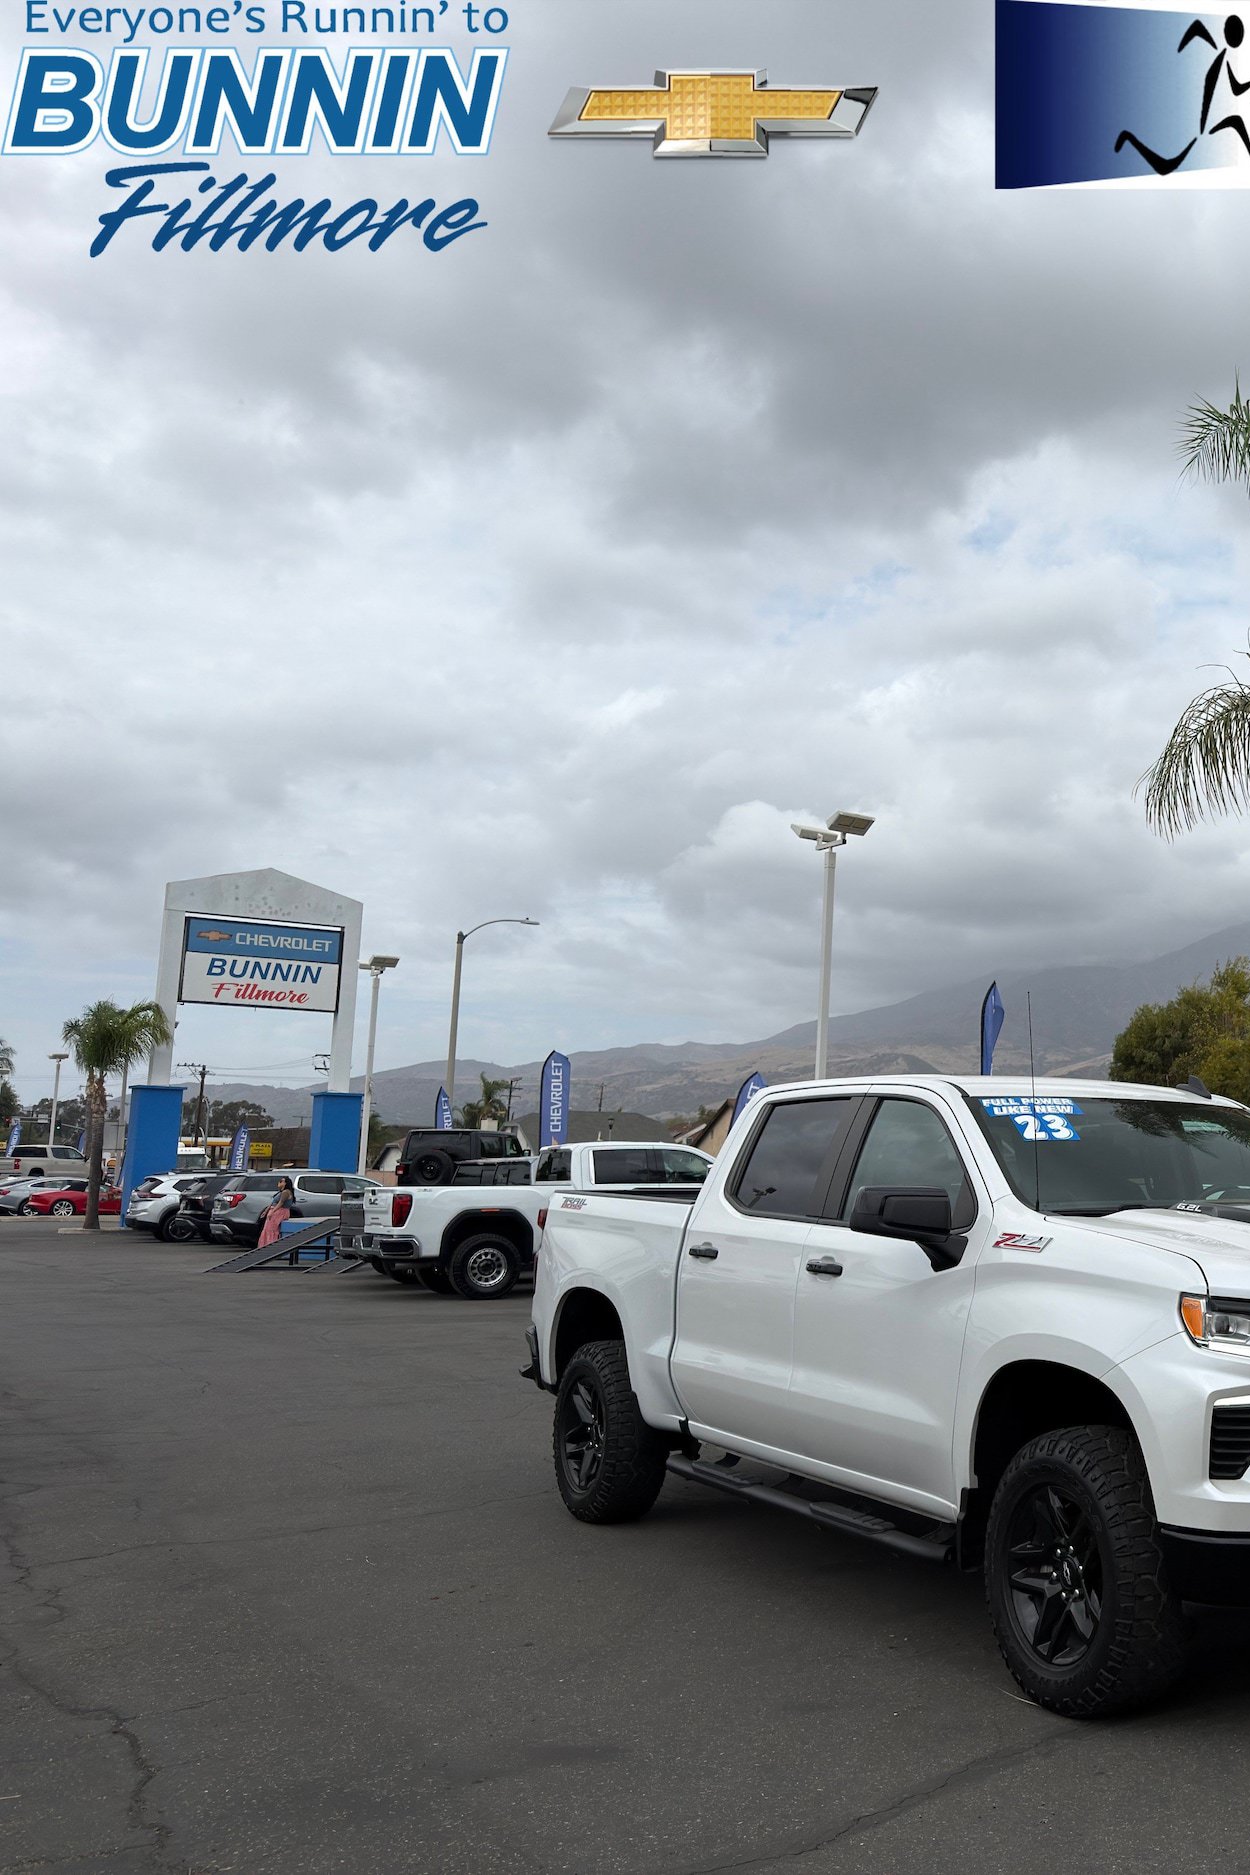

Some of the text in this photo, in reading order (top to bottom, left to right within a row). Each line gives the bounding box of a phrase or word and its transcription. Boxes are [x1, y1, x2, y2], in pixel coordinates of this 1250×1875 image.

[235, 932, 332, 952] CHEVROLET
[206, 957, 322, 984] BUNNIN
[211, 982, 309, 1004] Fillmore
[550, 1060, 563, 1133] CHEVROLET
[981, 1097, 1075, 1107] FULL POWER
[1014, 1114, 1074, 1140] 23
